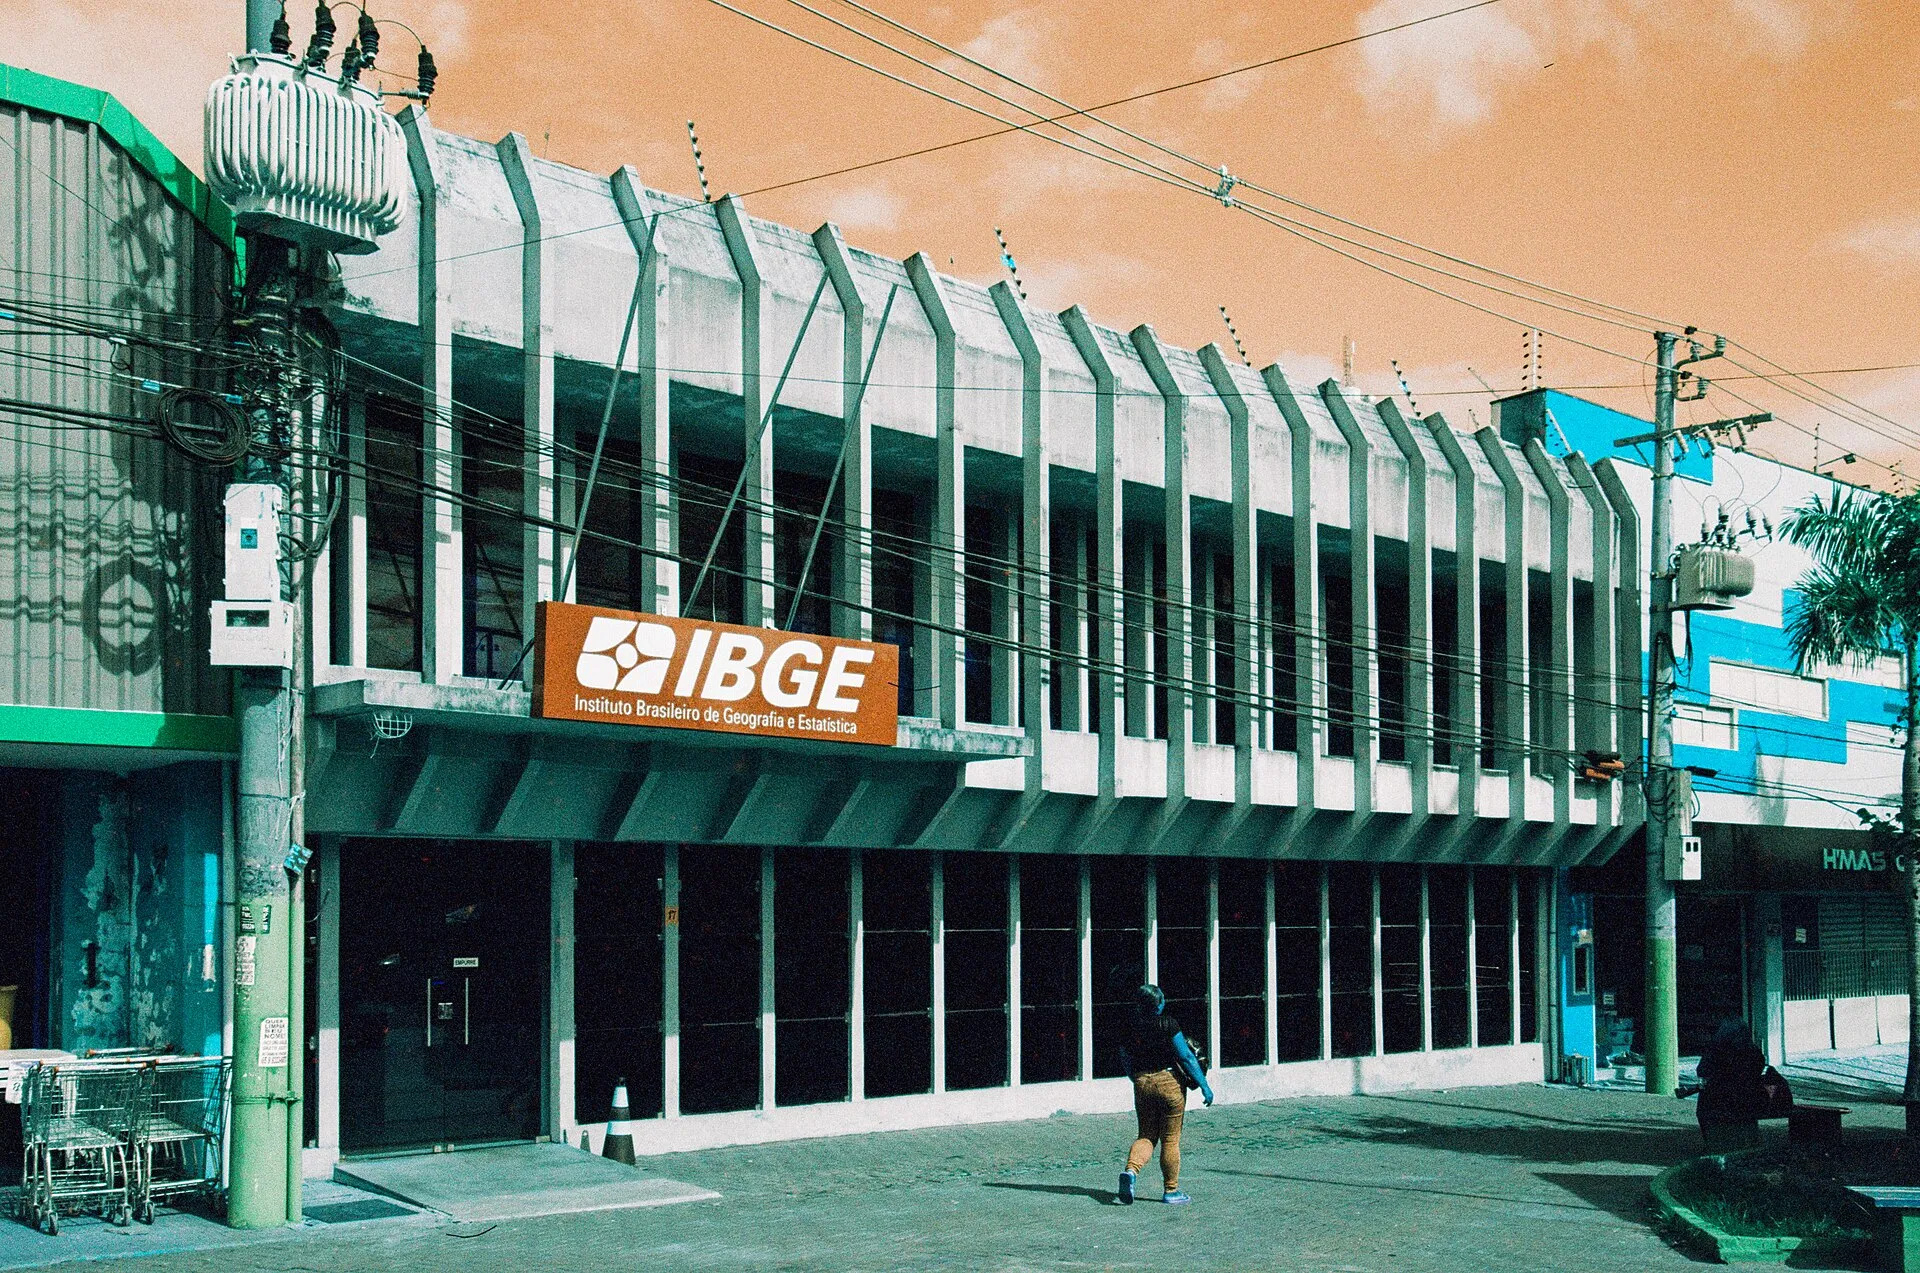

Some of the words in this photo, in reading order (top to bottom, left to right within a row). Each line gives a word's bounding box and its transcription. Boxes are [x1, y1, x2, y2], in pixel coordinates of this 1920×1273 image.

[674, 628, 875, 713] IBGE
[574, 694, 632, 716] Instituto
[636, 699, 700, 721] Brasileiro
[703, 706, 720, 723] de
[723, 707, 784, 730] Geografia
[787, 716, 795, 729] e
